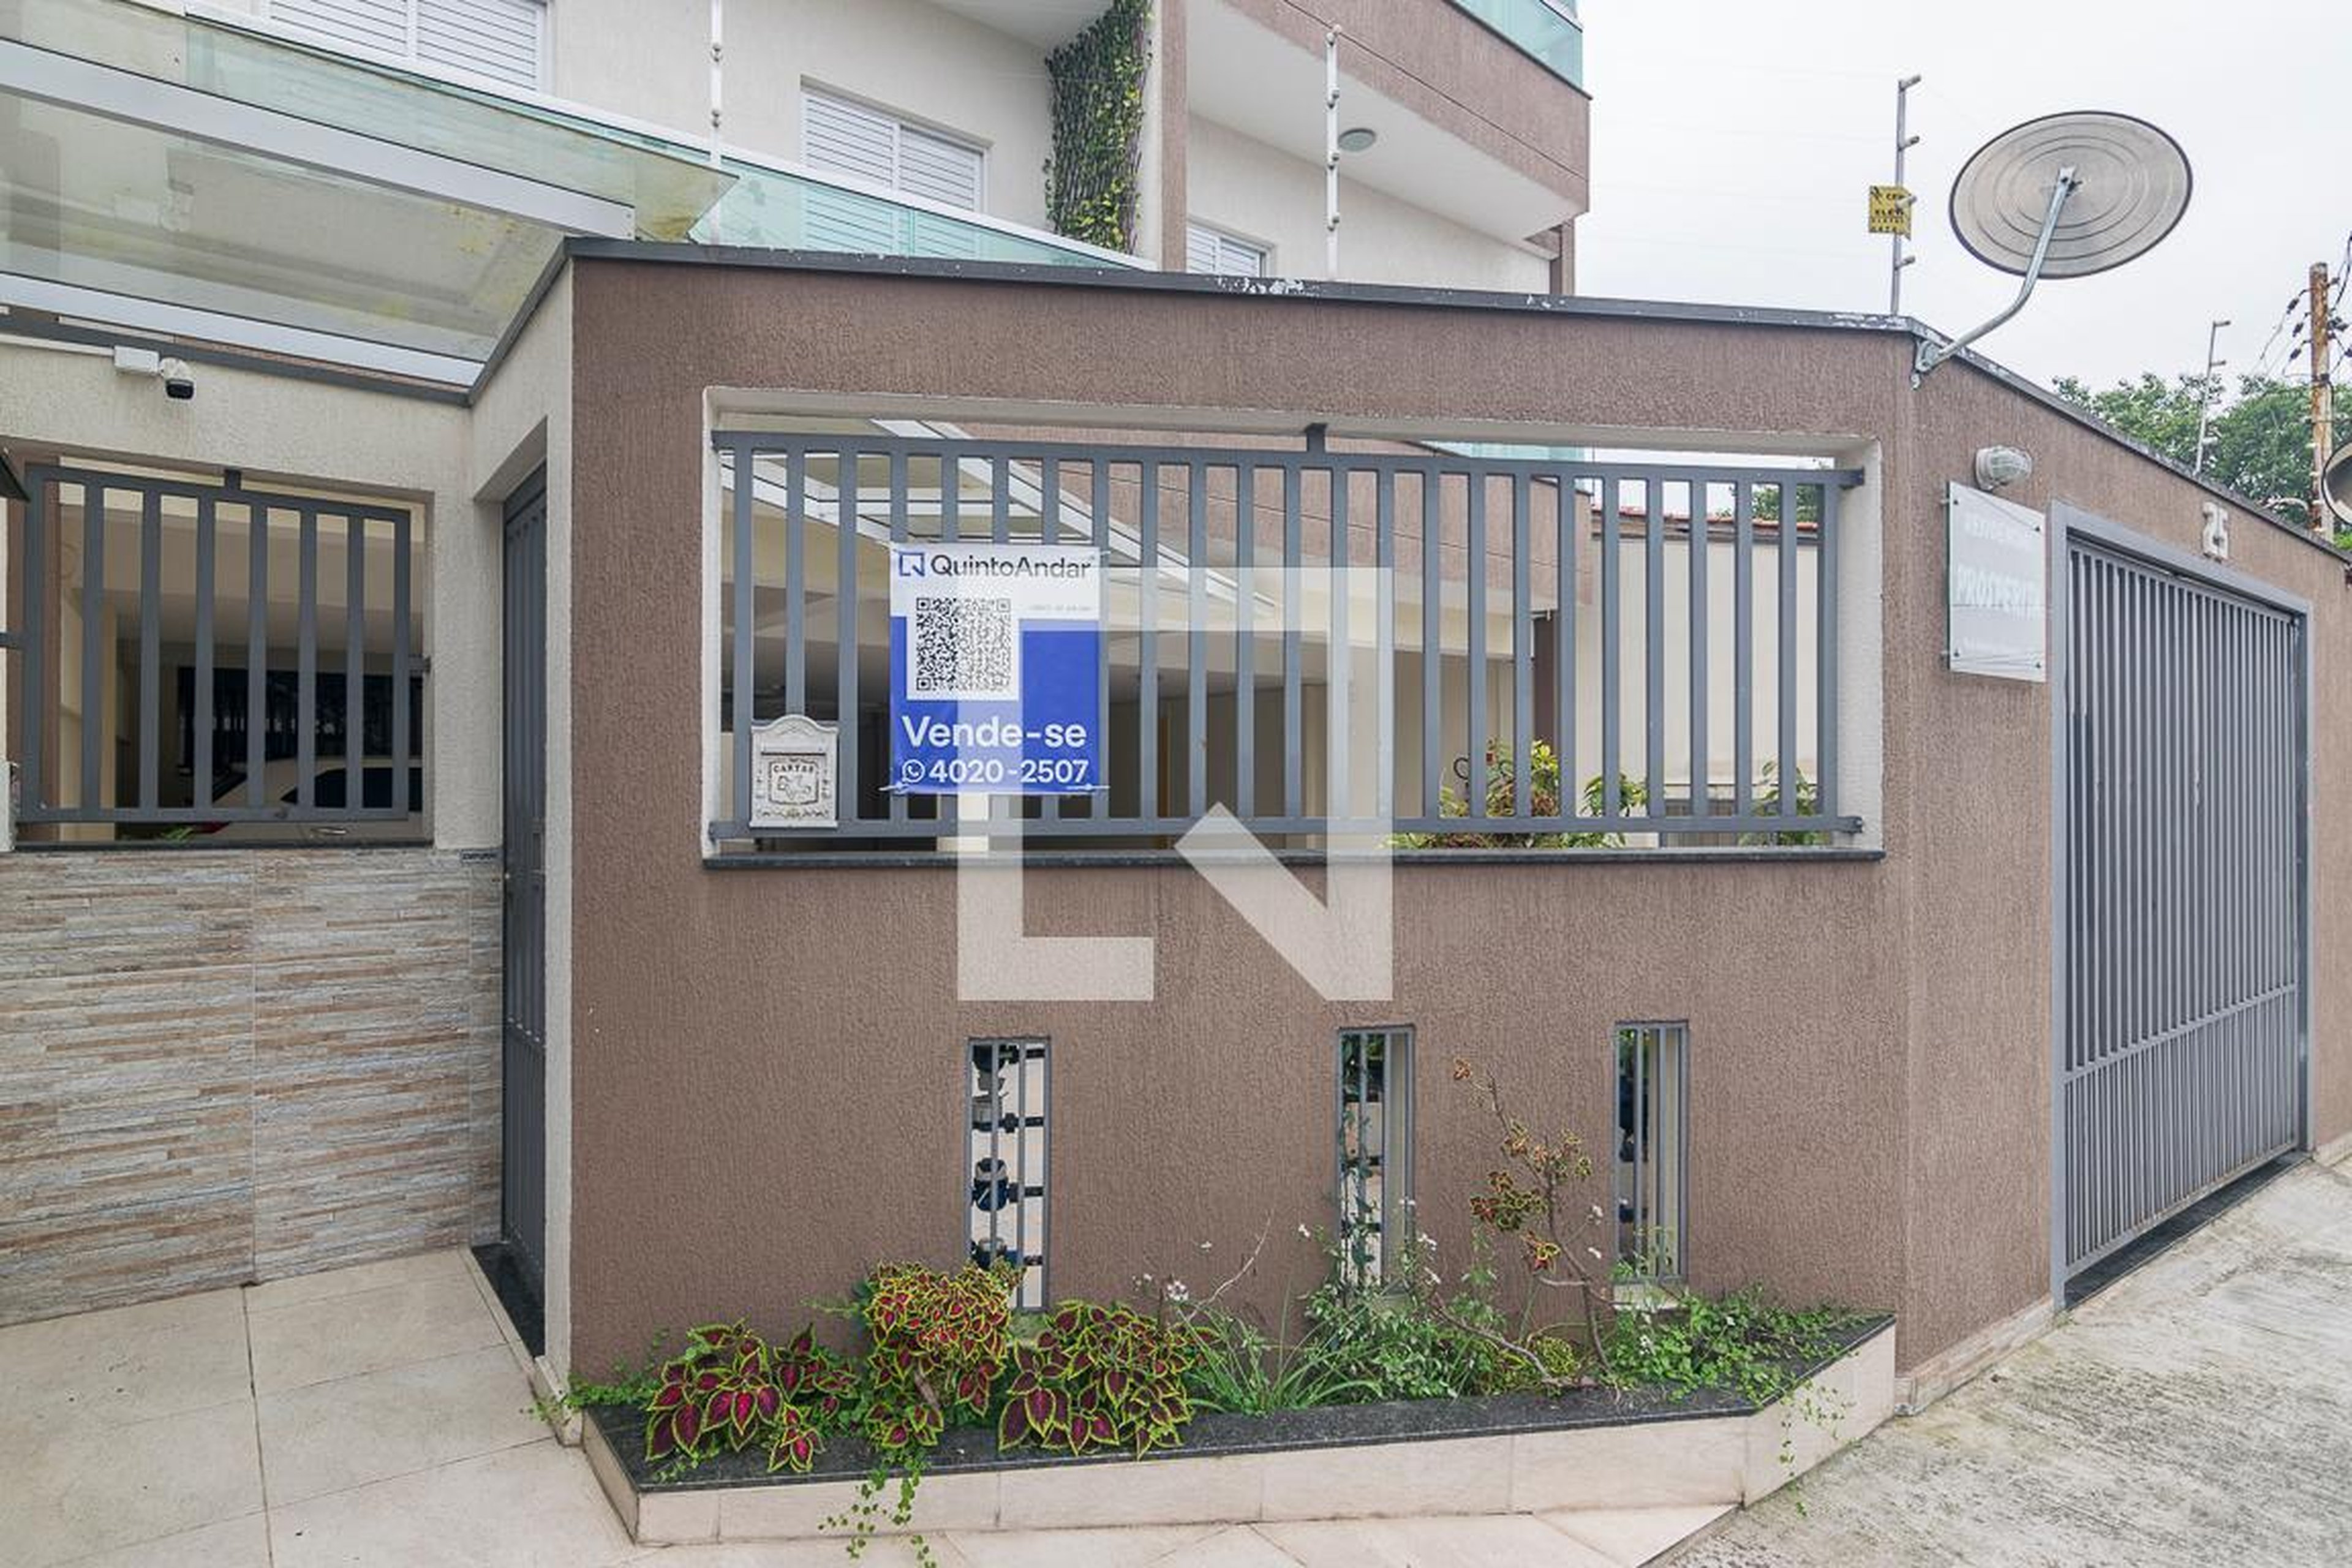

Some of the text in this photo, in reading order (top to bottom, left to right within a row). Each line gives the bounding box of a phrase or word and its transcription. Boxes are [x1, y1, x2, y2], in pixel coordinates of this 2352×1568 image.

[930, 554, 1091, 579] QuintoAndar
[901, 715, 1087, 748] Vende-se
[929, 759, 1089, 783] 4020-2507
